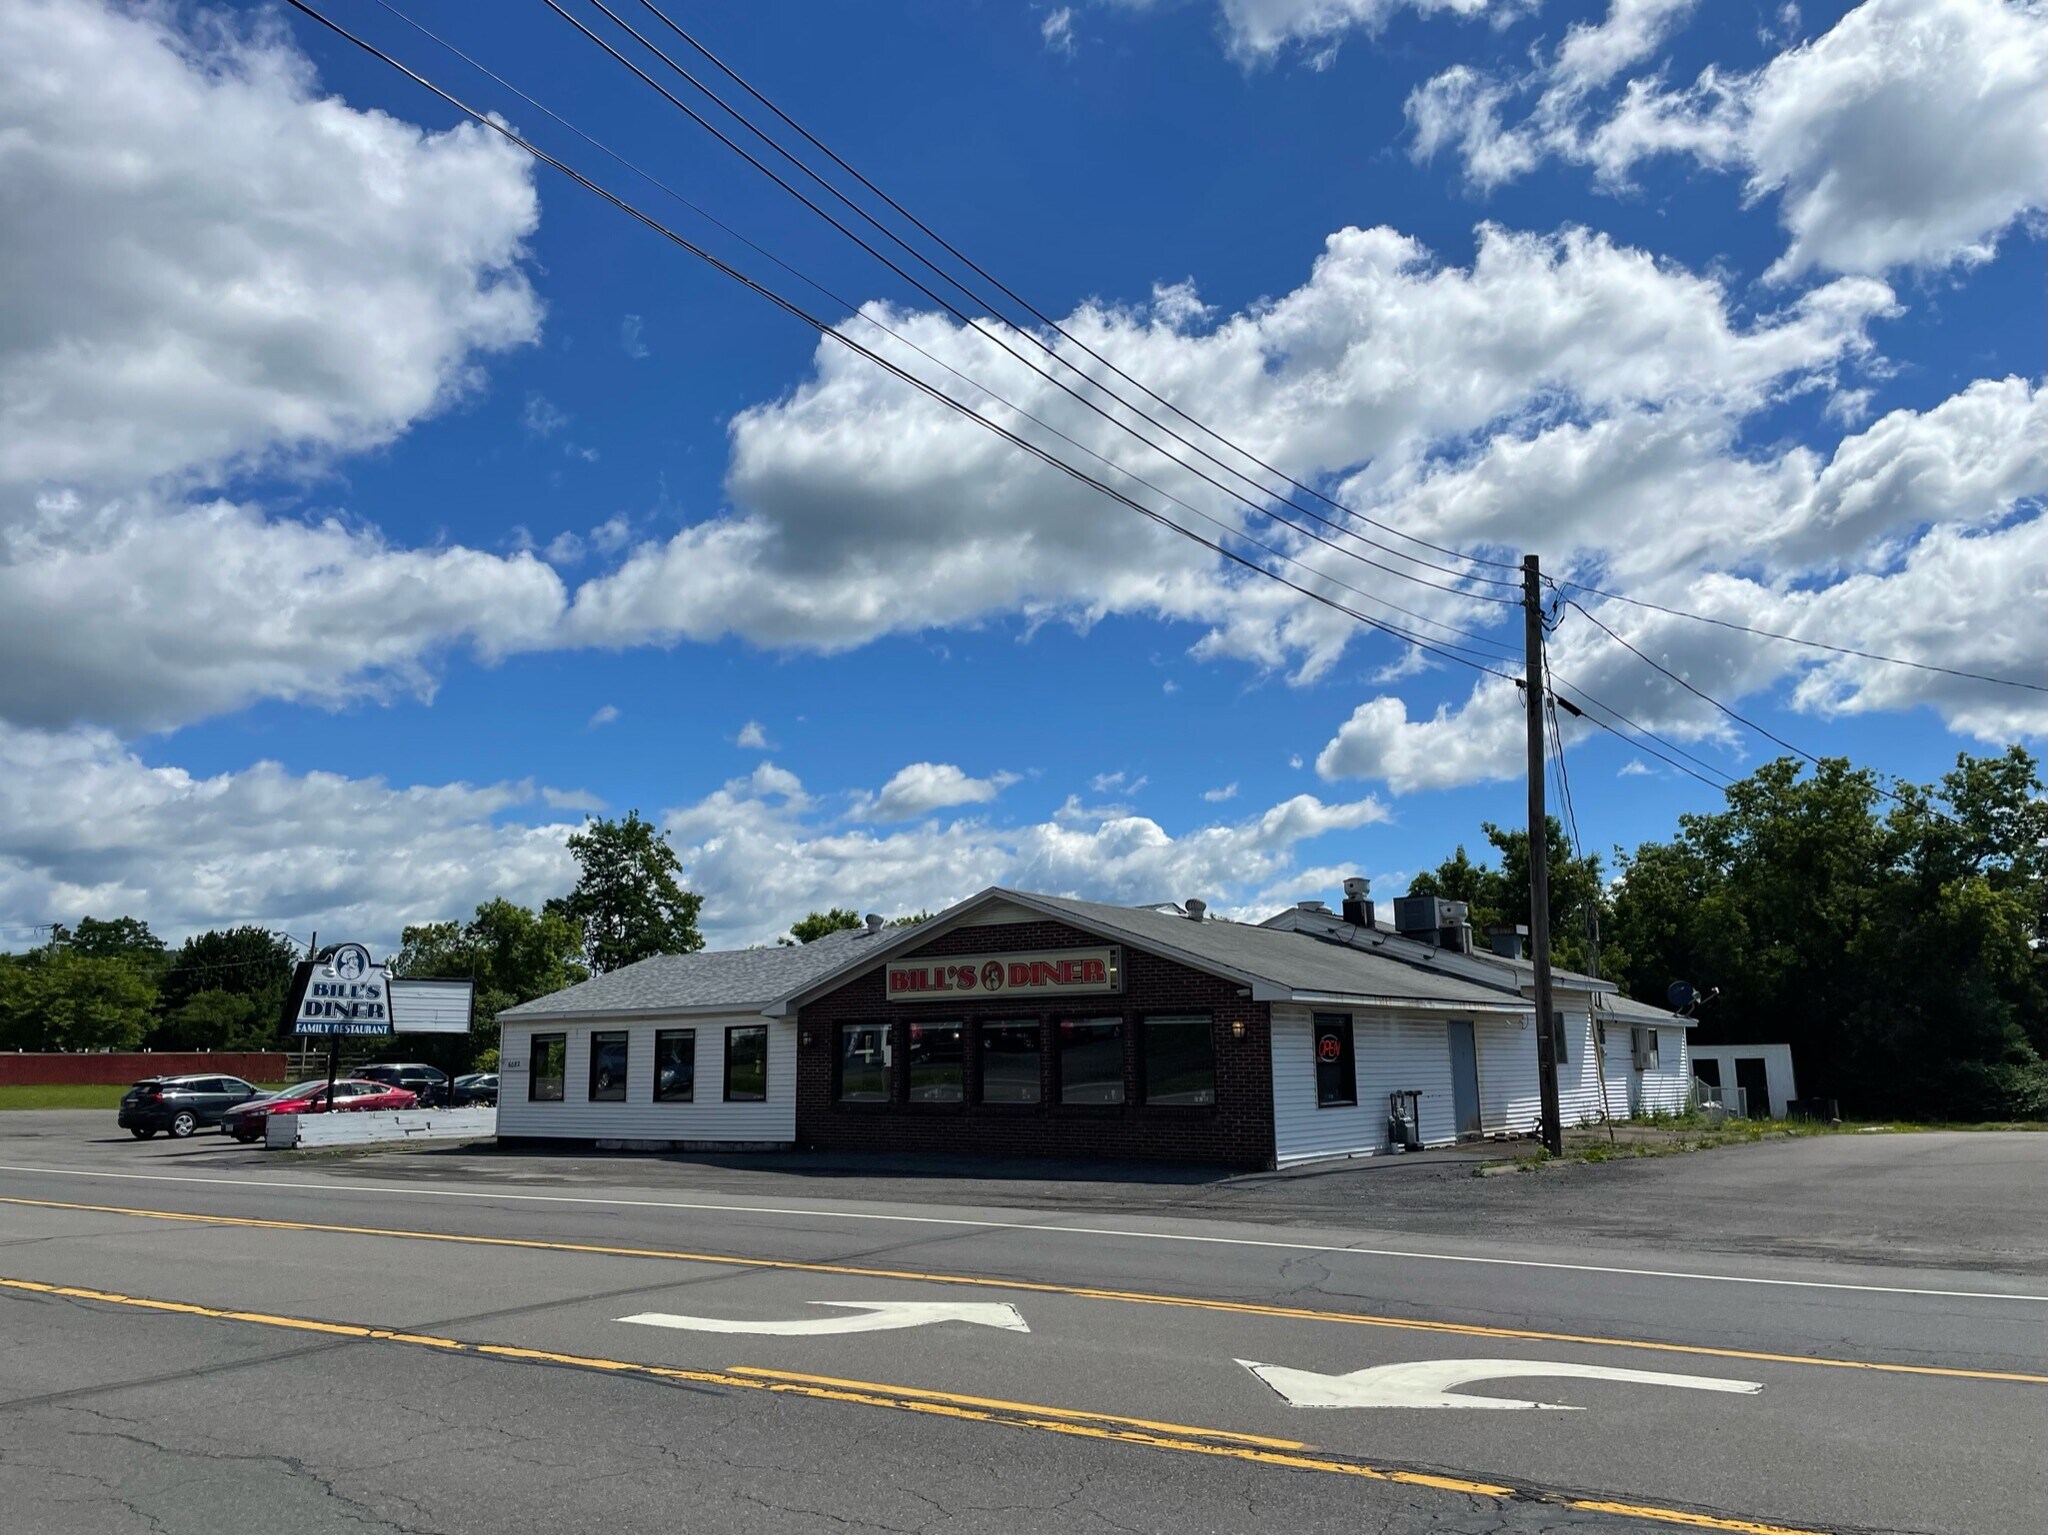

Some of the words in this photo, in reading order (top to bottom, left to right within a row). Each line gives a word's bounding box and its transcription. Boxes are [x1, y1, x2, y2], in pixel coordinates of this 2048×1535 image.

[889, 967, 977, 992] BILL'S
[1008, 959, 1106, 987] DINER
[312, 982, 381, 999] BILL'S
[303, 1000, 385, 1019] DINER
[296, 1023, 330, 1033] FAMILY
[333, 1024, 388, 1035] RESTAURANT
[1319, 1040, 1340, 1057] OPEN
